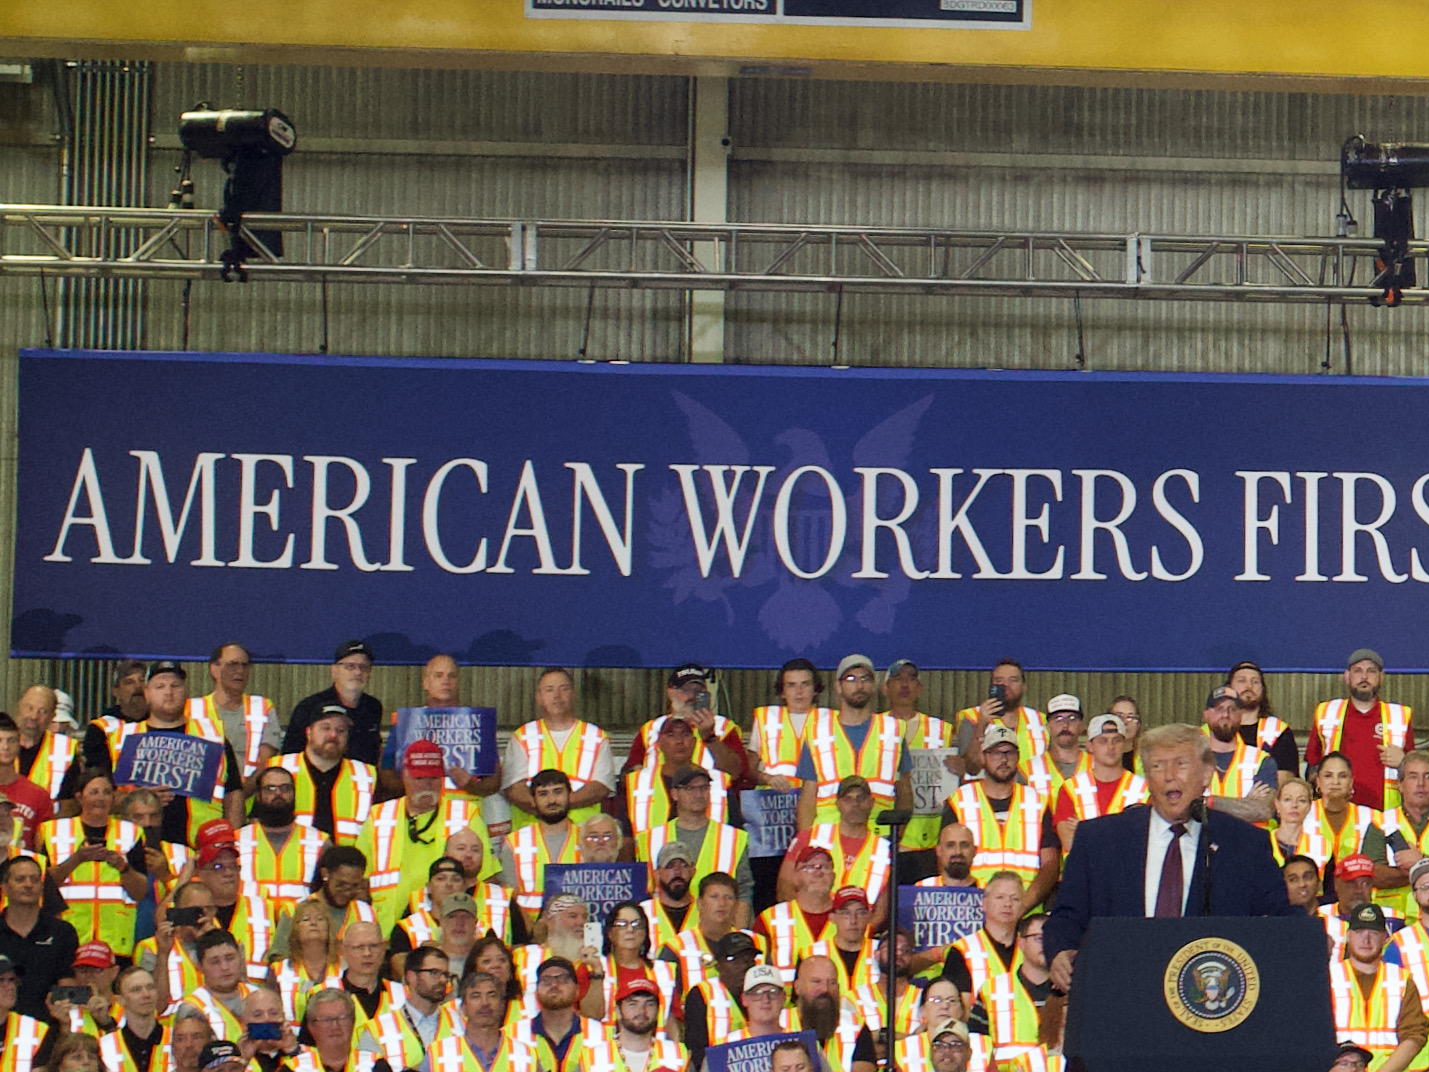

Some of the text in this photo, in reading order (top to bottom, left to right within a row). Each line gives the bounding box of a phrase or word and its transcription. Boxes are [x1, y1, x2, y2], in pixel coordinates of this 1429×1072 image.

[42, 447, 645, 577] AMERICAN
[668, 464, 1203, 582] WORKERS
[416, 713, 481, 728] AMERICAN
[415, 729, 481, 745] WORKERS
[137, 735, 209, 757] AMERICAN
[136, 747, 205, 769] WORKERS
[438, 745, 481, 771] RST
[912, 754, 943, 769] ICAN
[128, 760, 201, 793] FIRST
[760, 794, 798, 810] AMERI
[761, 825, 796, 850] FIR
[562, 868, 633, 884] AMERICAN
[561, 885, 634, 901] WORKERS
[913, 891, 984, 906] AMERICAN
[914, 906, 984, 921] WORKERS
[753, 967, 774, 978] USA
[727, 1038, 783, 1064] AMERIC
